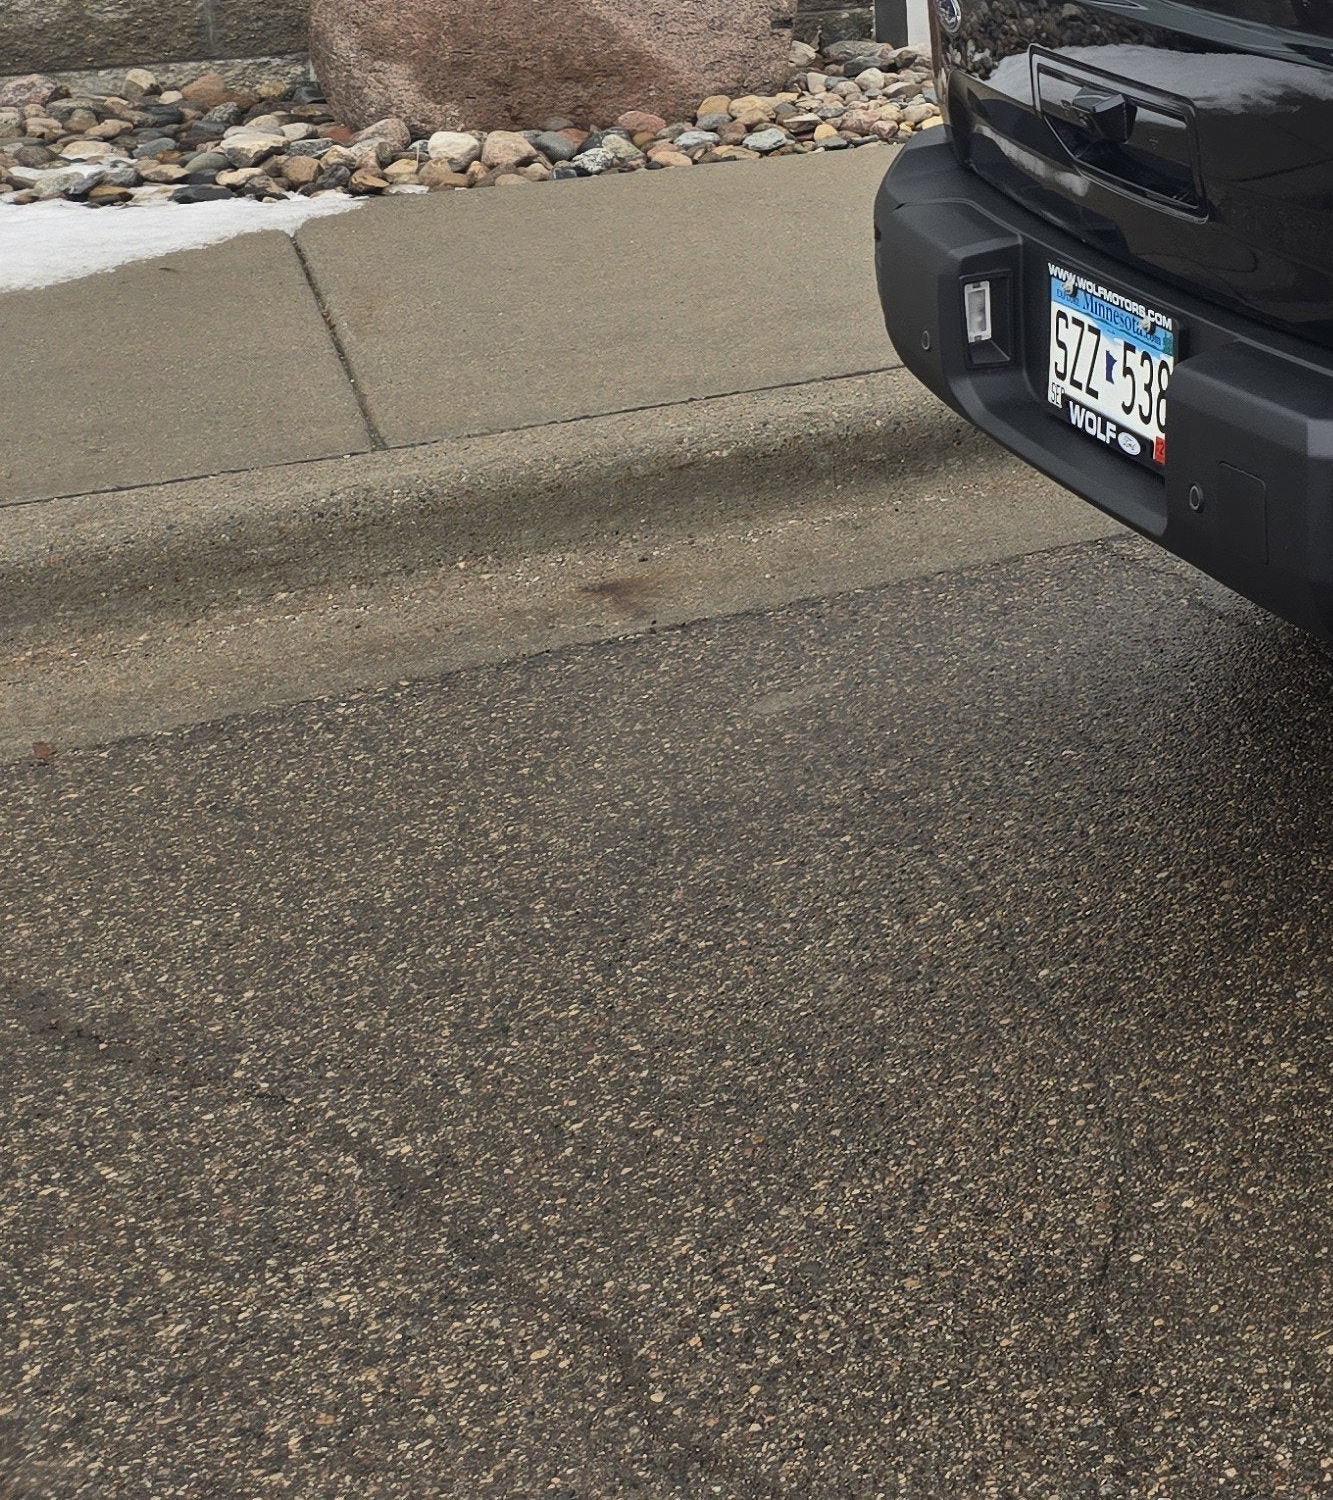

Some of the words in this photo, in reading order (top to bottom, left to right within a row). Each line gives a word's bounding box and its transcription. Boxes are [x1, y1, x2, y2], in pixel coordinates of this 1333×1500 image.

[1047, 262, 1173, 332] WWW.WOLFMOTORS.COM
[1054, 309, 1101, 400] SZZ
[1120, 340, 1170, 434] 538
[1069, 400, 1117, 444] WOLF
